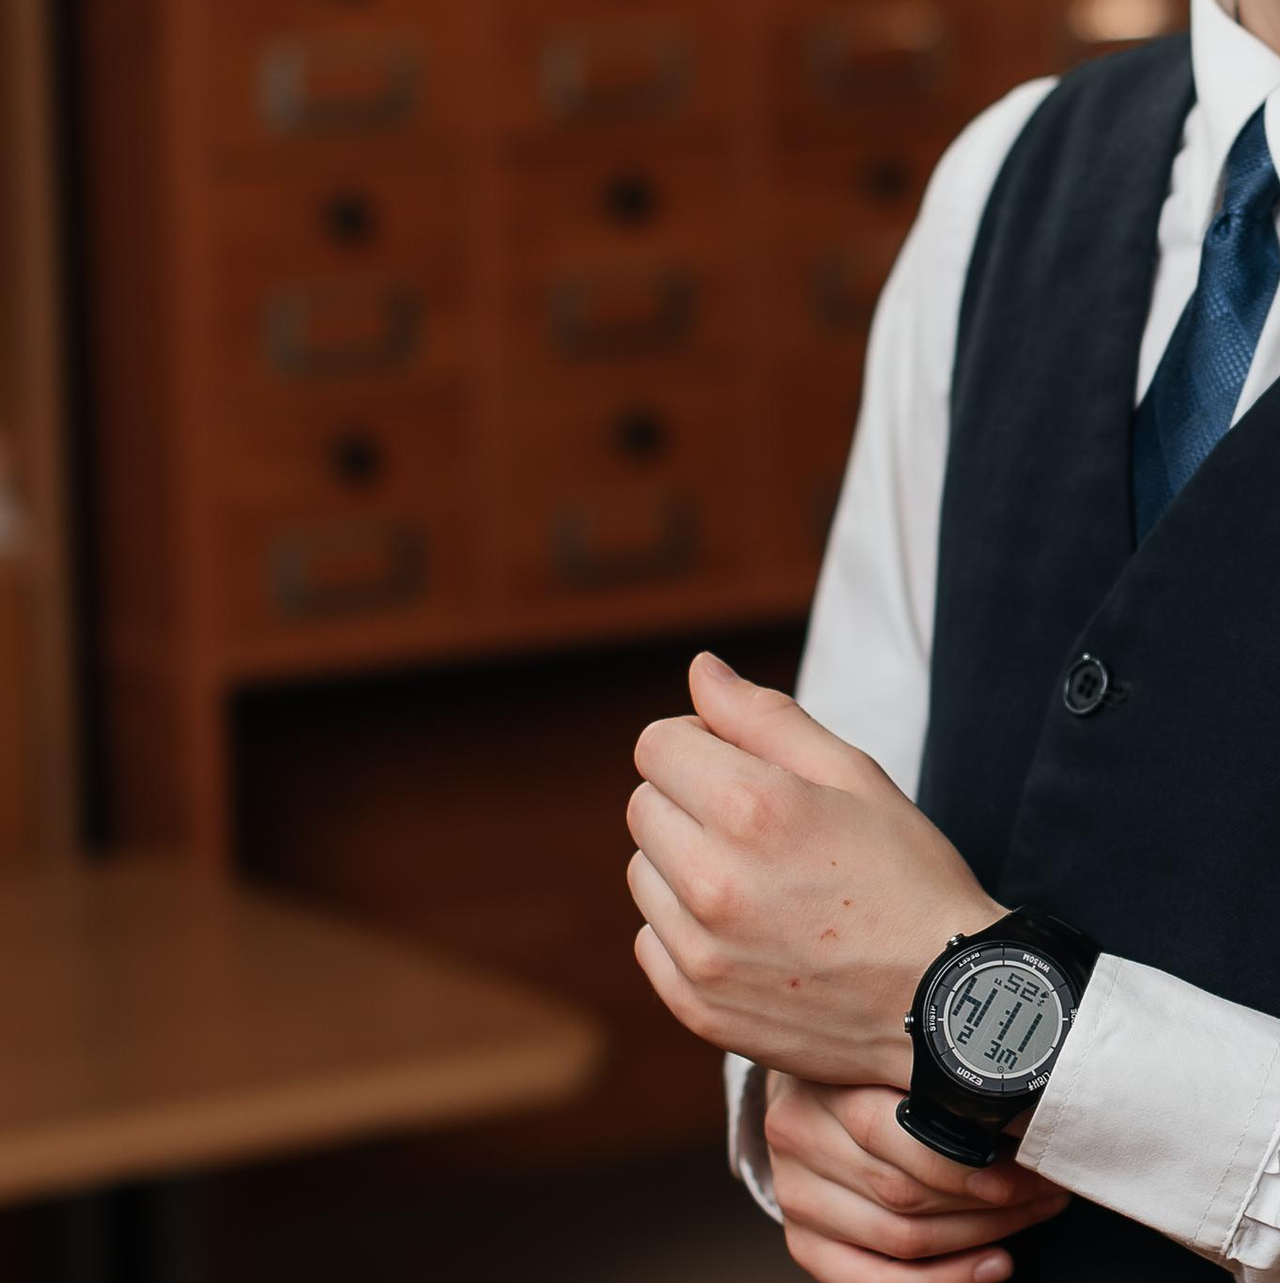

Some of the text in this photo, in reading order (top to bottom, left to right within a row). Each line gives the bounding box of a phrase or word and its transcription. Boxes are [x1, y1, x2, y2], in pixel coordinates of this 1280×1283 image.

[1022, 953, 1050, 973] WR50M
[1004, 972, 1040, 1003] 25
[984, 1039, 1018, 1070] WE
[956, 1066, 983, 1086] EZON
[1027, 1071, 1051, 1091] LIGHT
